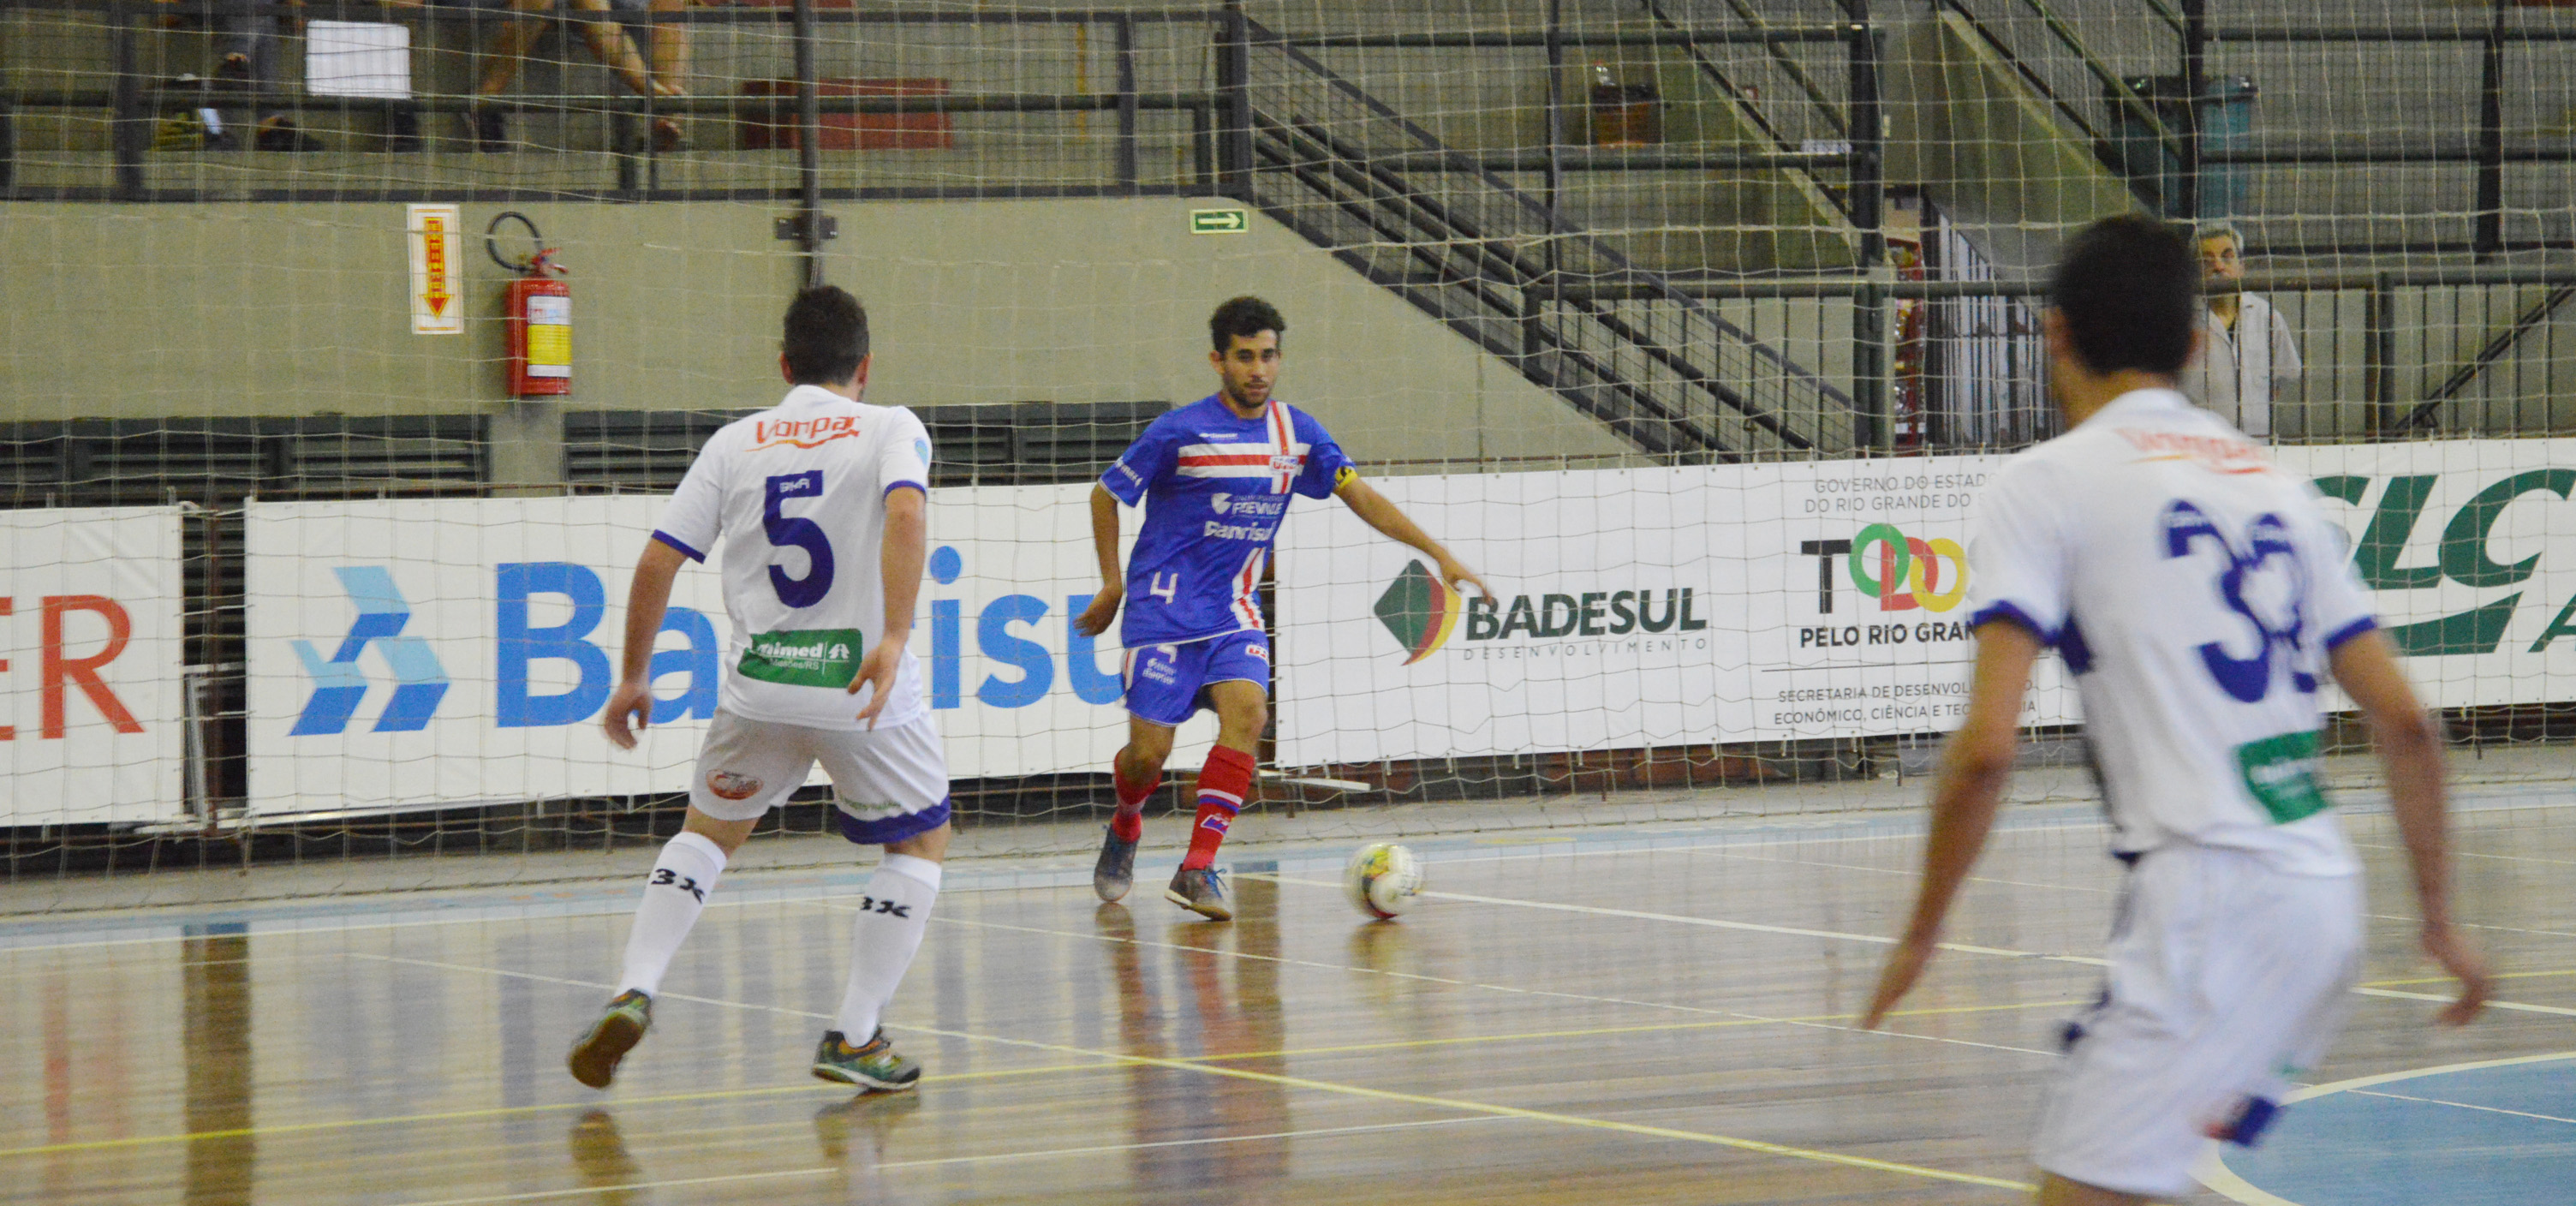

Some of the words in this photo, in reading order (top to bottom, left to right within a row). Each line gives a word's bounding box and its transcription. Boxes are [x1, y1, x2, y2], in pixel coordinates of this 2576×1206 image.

[1815, 476, 1899, 493] GOVERNO
[1905, 475, 1928, 490] DO
[1804, 499, 1830, 513] DO
[1836, 498, 1865, 512] RIO
[1871, 495, 1941, 510] GRANDE
[1947, 493, 1971, 507] DO
[762, 470, 835, 608] 5
[1801, 522, 1977, 614] TODO
[1149, 571, 1178, 605] 4
[1465, 588, 1707, 641] BADESUL
[1800, 624, 1859, 648] PELO
[1869, 624, 1908, 645] RIO
[756, 642, 824, 659] nimed
[1464, 637, 1707, 660] DESENVOLVIMENTO
[1779, 687, 1868, 702] SECRETARIA
[1872, 686, 1890, 698] DE
[1774, 707, 1867, 725] ECONÔMICO,
[1871, 704, 1928, 720] CIÊNCIA
[1933, 704, 1941, 716] E
